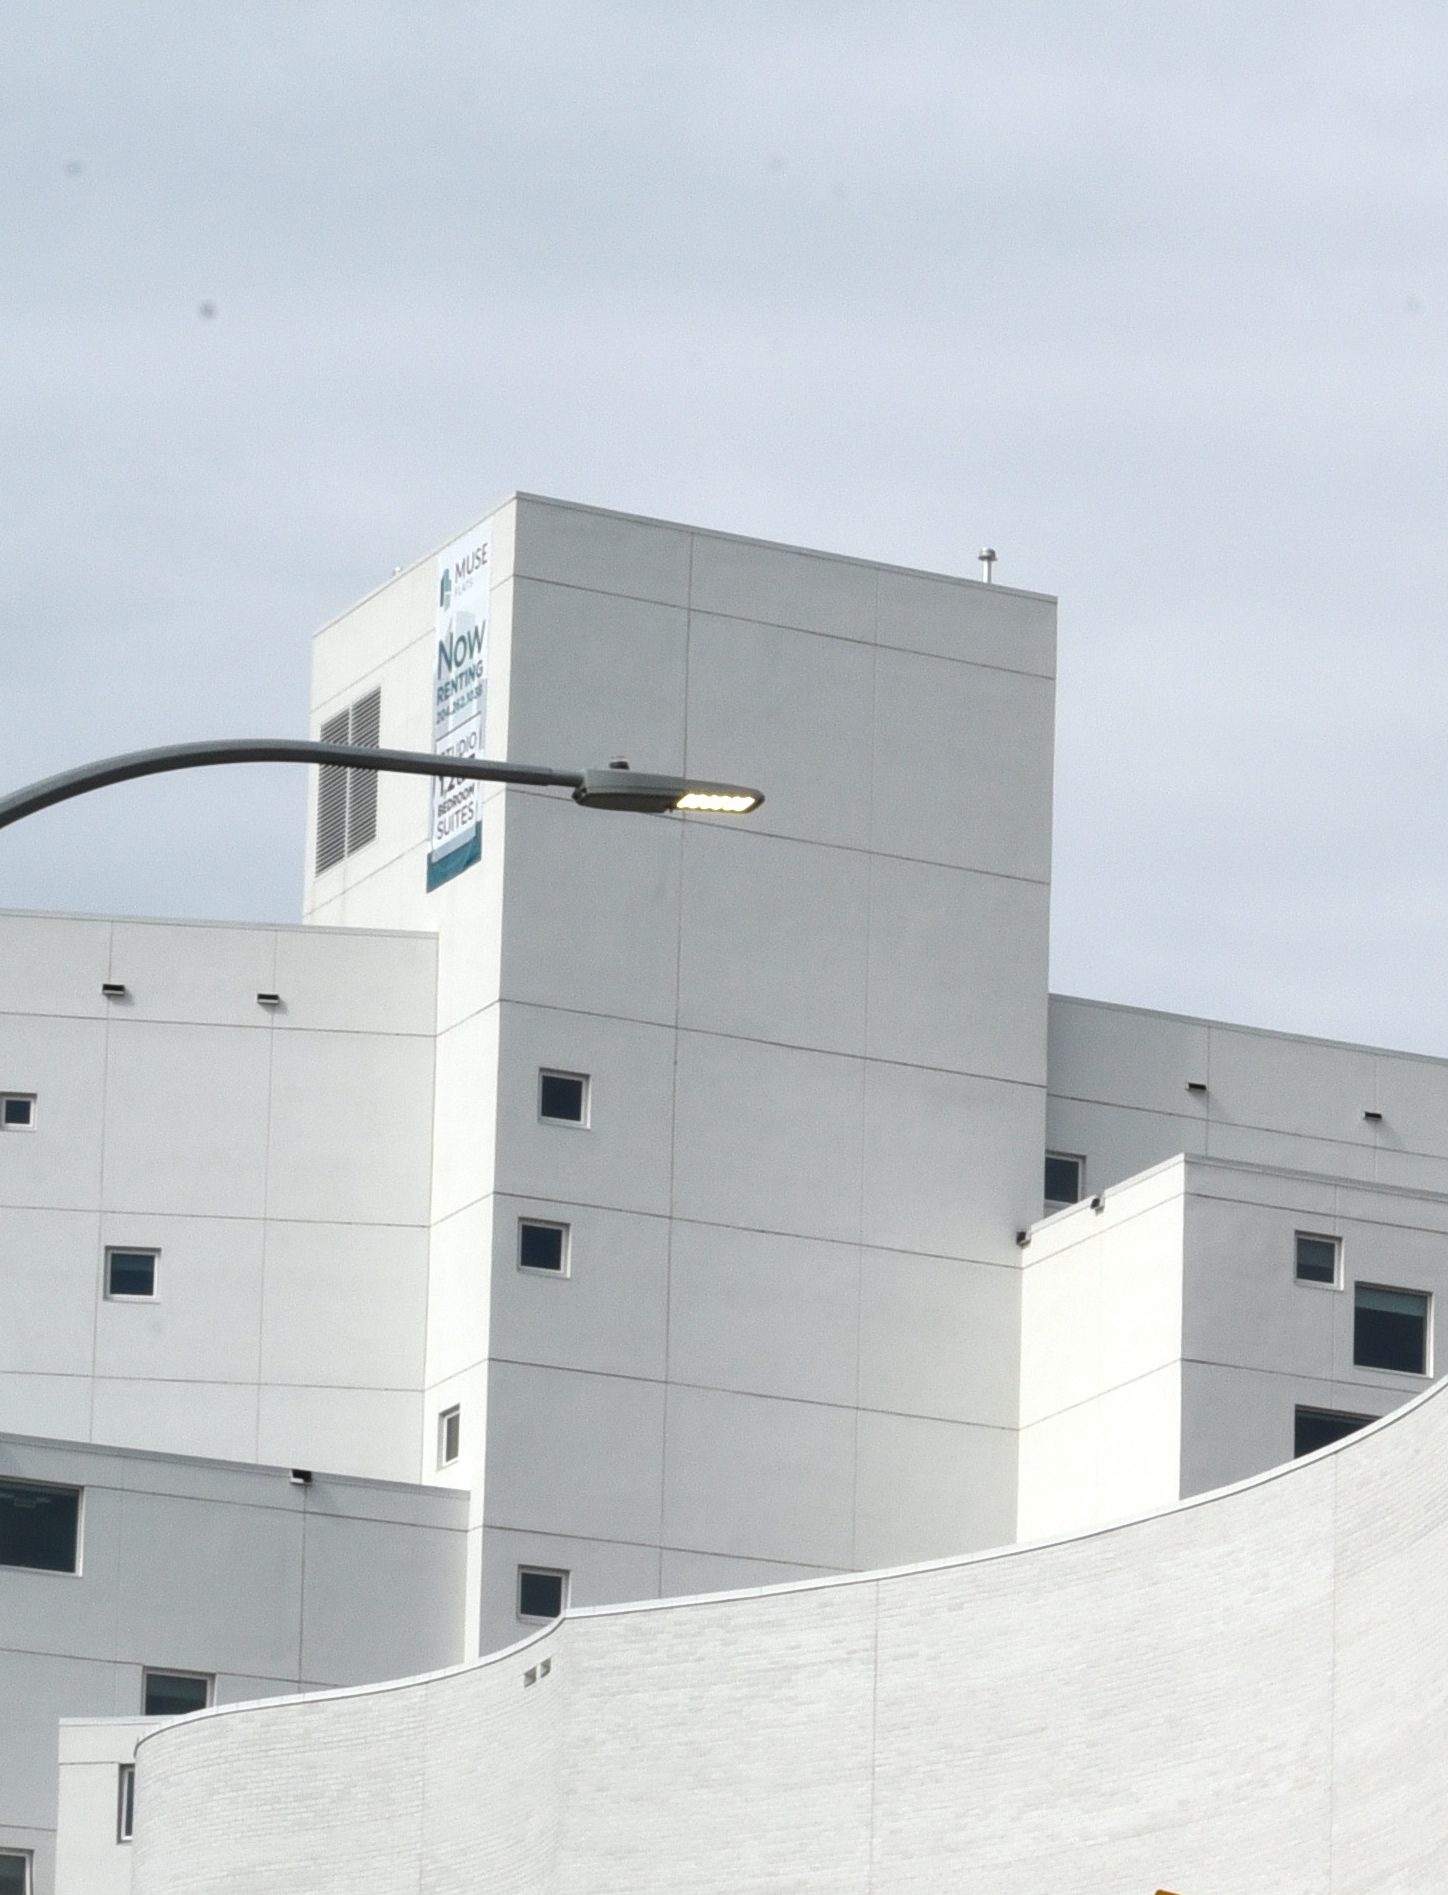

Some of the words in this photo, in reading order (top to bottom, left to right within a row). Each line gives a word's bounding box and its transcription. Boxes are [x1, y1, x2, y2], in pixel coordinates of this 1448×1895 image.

[455, 543, 488, 583] MUSE
[437, 620, 486, 680] NOW
[437, 659, 483, 706] RENTING
[440, 731, 477, 758] TUDIO
[438, 784, 475, 817] BEDROOM
[436, 801, 474, 840] SUITES
